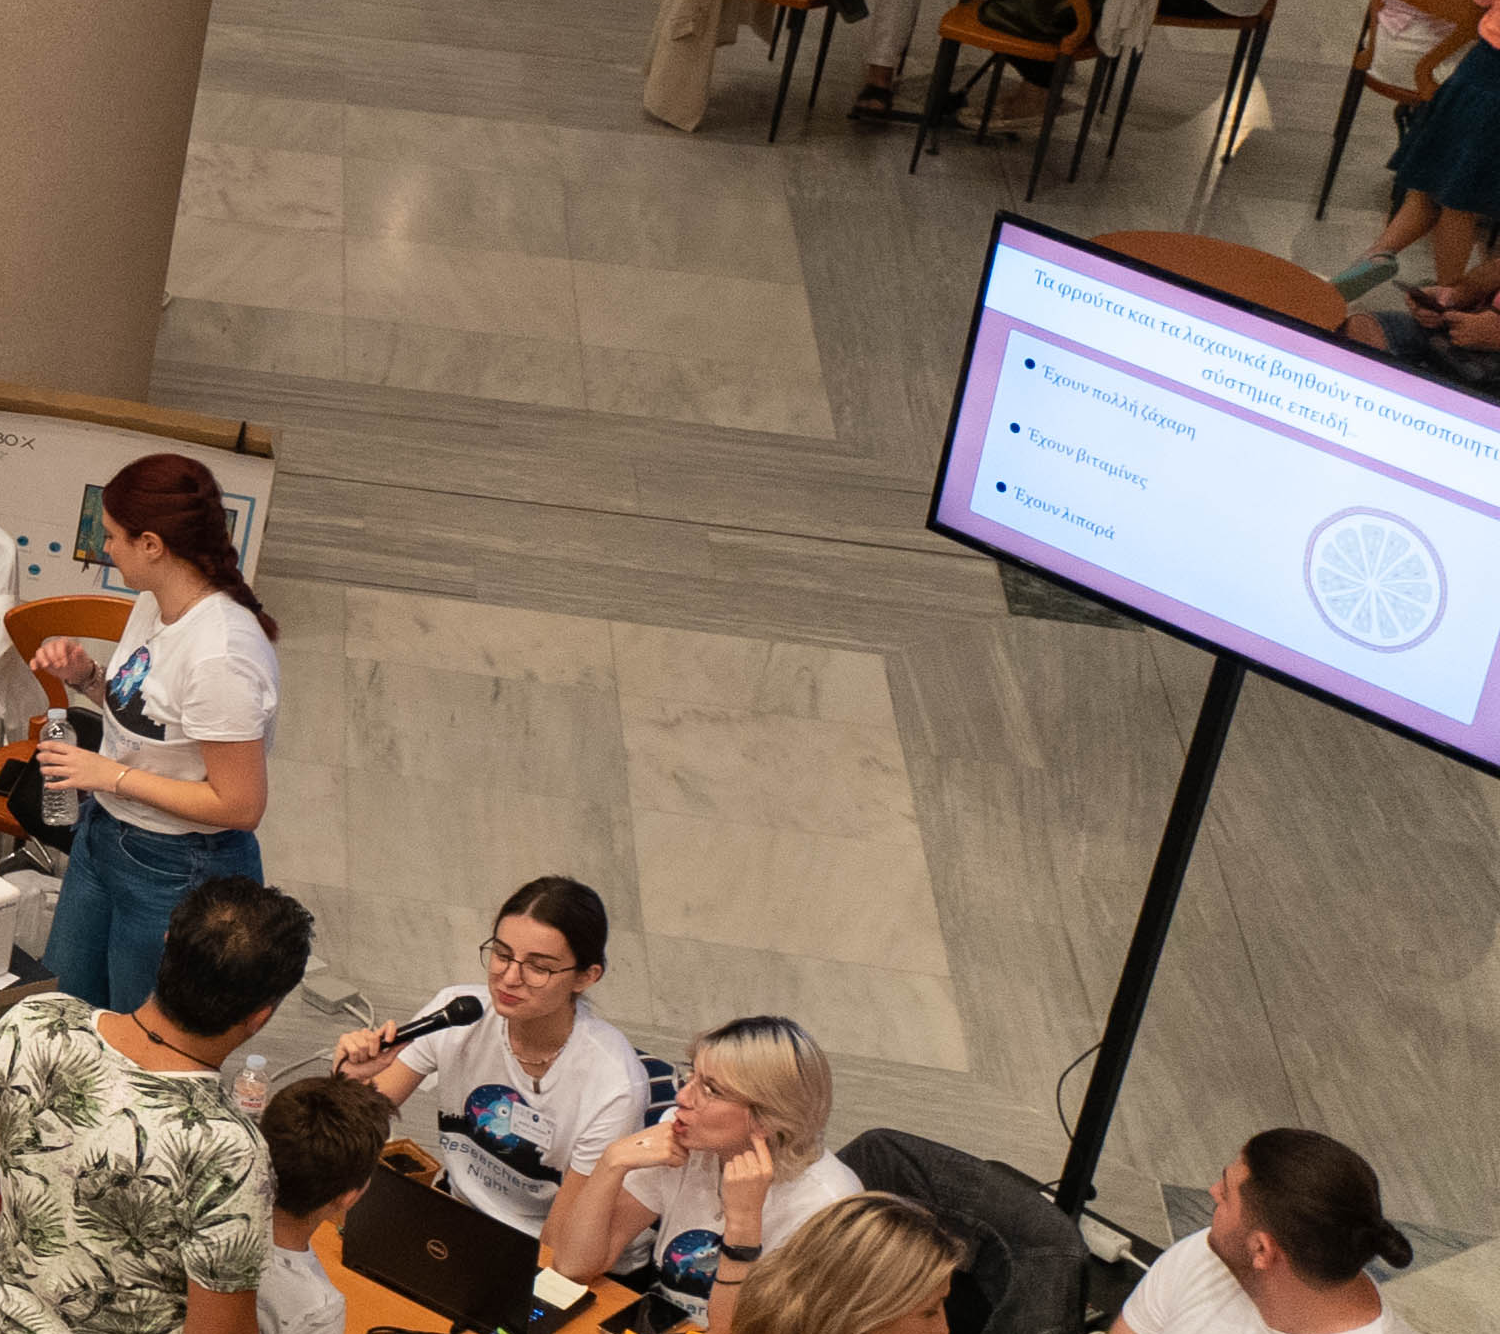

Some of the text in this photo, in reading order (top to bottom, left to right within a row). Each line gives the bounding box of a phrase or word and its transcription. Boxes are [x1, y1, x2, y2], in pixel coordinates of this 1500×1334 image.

[1035, 268, 1054, 291] Τα
[1058, 280, 1126, 317] φρούτα
[1128, 309, 1155, 329] και
[1160, 320, 1181, 338] τα
[1183, 326, 1265, 372] λαχανικά
[1269, 359, 1351, 403] βοηθούν
[1355, 394, 1375, 413] το
[1042, 363, 1197, 442] Έχουν πολλή ζάχαρη
[1027, 426, 1149, 491] Έχουν βιταμίνες
[1014, 483, 1117, 542] Έχουν λιπαρά
[439, 1136, 544, 1194] Researchers'
[466, 1163, 509, 1196] Night
